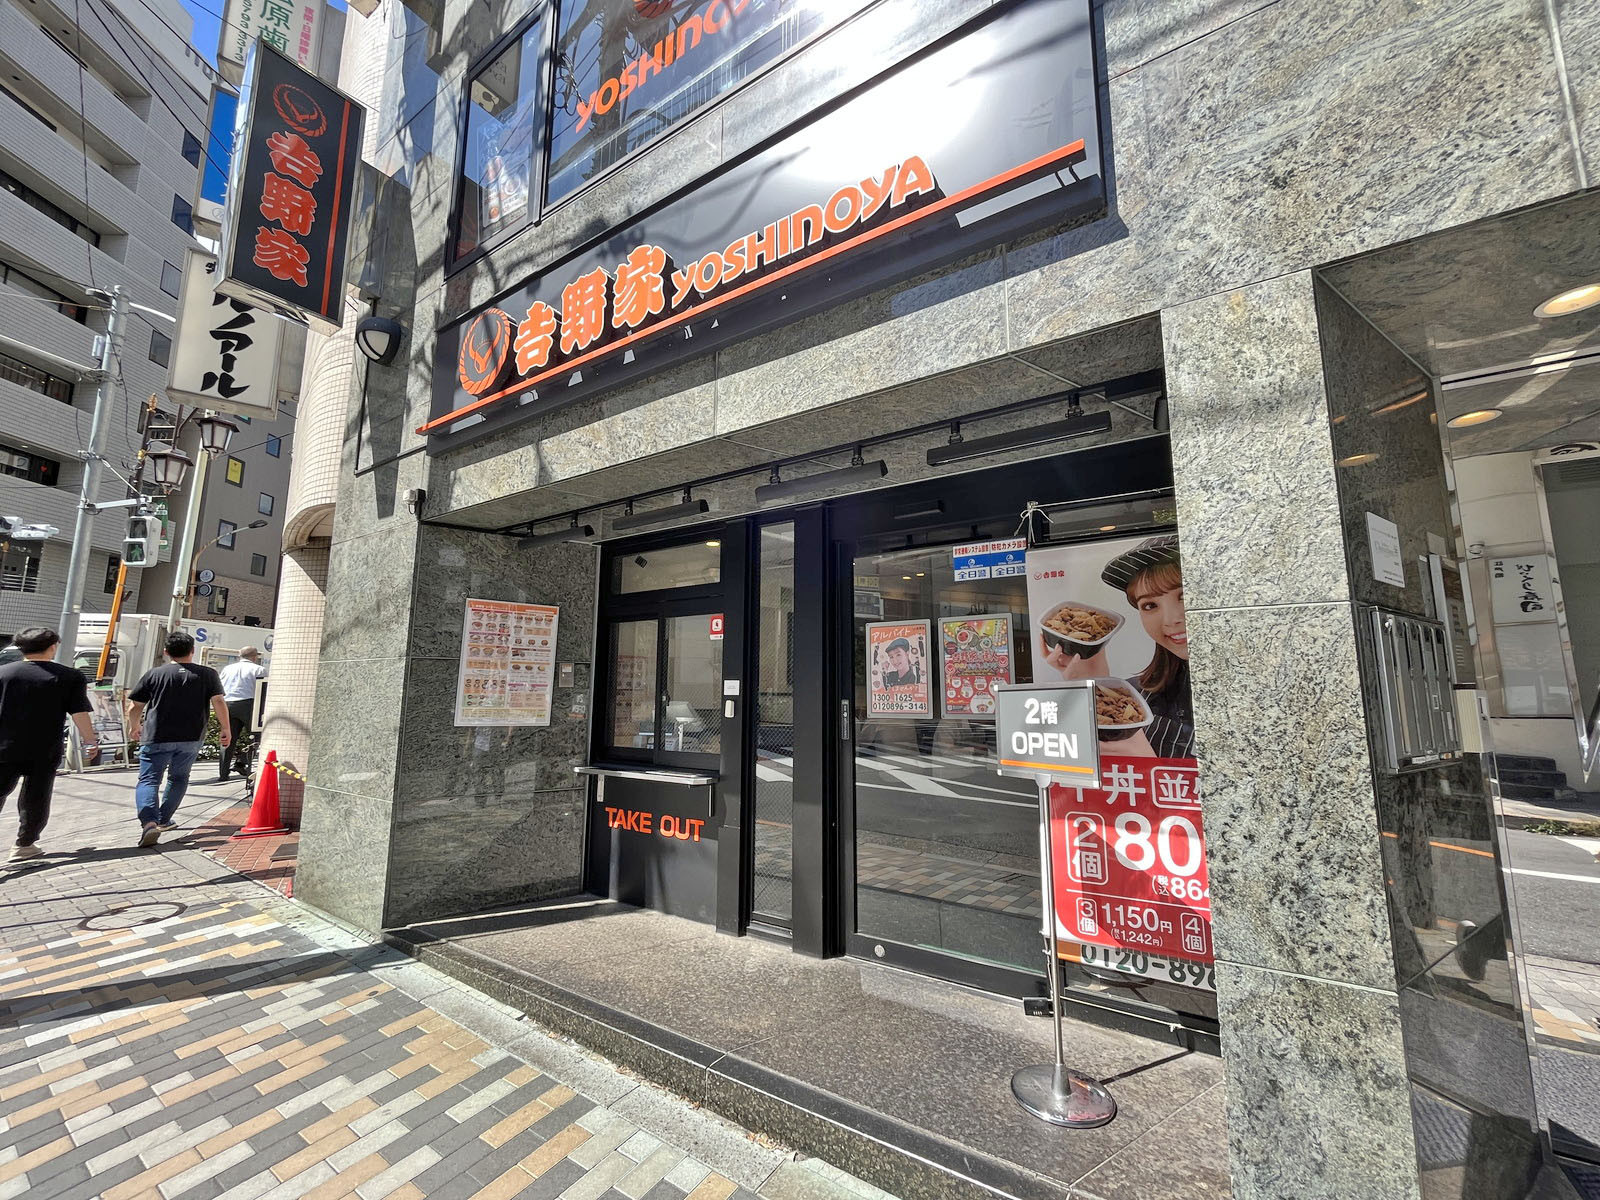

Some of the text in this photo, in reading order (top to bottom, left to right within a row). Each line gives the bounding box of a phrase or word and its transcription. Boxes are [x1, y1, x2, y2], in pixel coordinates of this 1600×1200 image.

[258, 0, 295, 54] 原歯
[253, 131, 323, 288] 吉野家
[512, 154, 937, 377] 吉野家 YOSHINOYA
[872, 627, 911, 640] アルバイト
[873, 694, 913, 702] 1300 1625
[1024, 698, 1059, 725] 2階
[1011, 731, 1079, 759] OPEN
[605, 806, 705, 842] TAKE OUT
[1101, 903, 1173, 934] 1,150円
